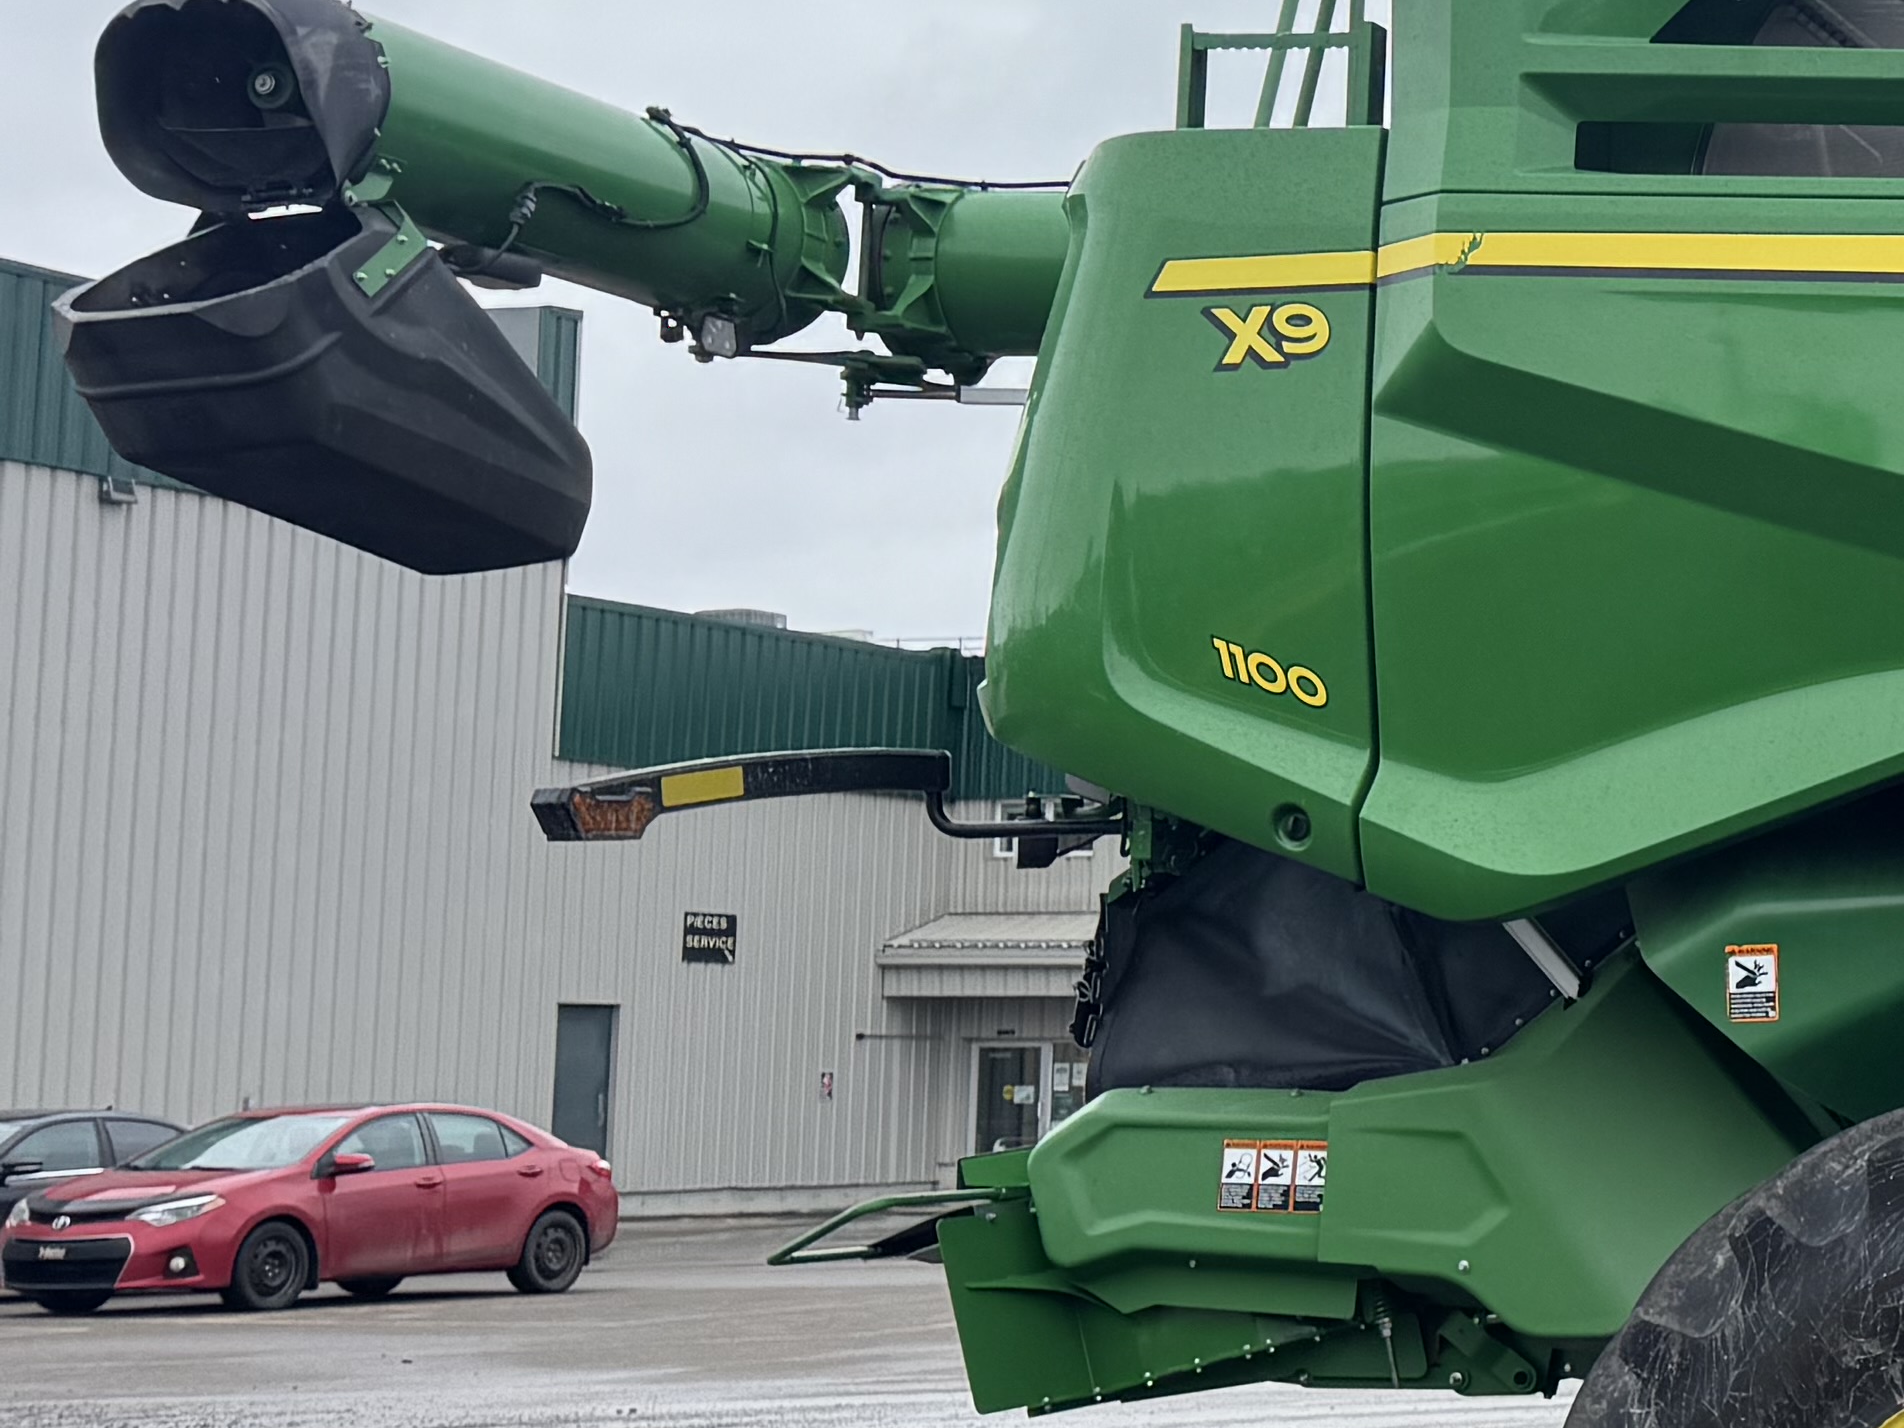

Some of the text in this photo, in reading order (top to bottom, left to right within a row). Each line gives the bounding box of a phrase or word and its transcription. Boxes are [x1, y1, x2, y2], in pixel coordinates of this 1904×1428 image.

[1204, 303, 1331, 371] X9
[1212, 636, 1328, 707] 1100
[686, 934, 735, 950] SERVICE
